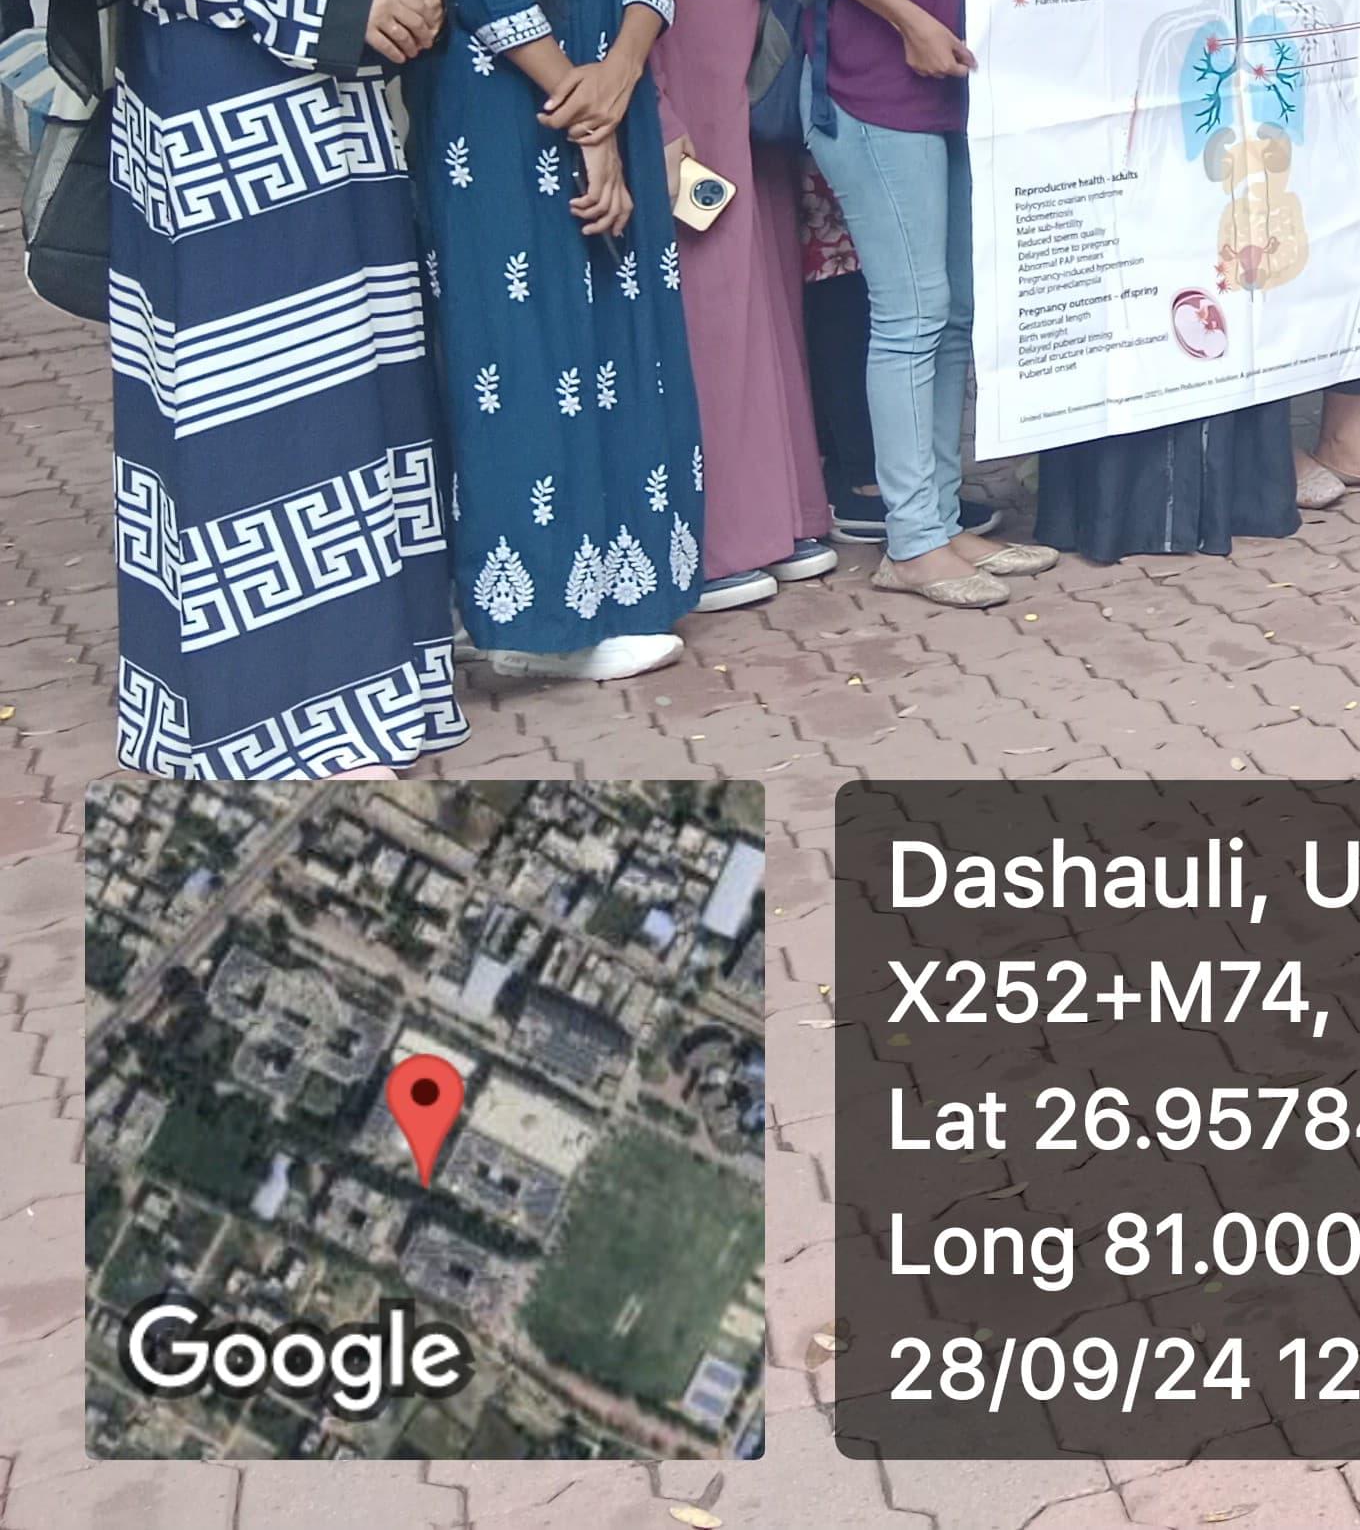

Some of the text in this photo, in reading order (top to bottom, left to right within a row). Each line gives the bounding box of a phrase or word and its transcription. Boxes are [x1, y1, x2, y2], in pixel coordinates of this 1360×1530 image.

[1015, 181, 1077, 196] Reproductive
[1078, 176, 1105, 188] health
[1112, 170, 1138, 182] adults
[1015, 190, 1123, 212] Polycystic ovarian syndrome
[1016, 210, 1073, 224] Endometriosis
[1019, 302, 1067, 318] Pregnancy
[1069, 294, 1112, 308] outcomes
[1120, 285, 1158, 299] offspring
[1019, 311, 1091, 332] Gestational length
[1019, 327, 1068, 344] Birth weight
[1019, 362, 1077, 379] Pubertal onset
